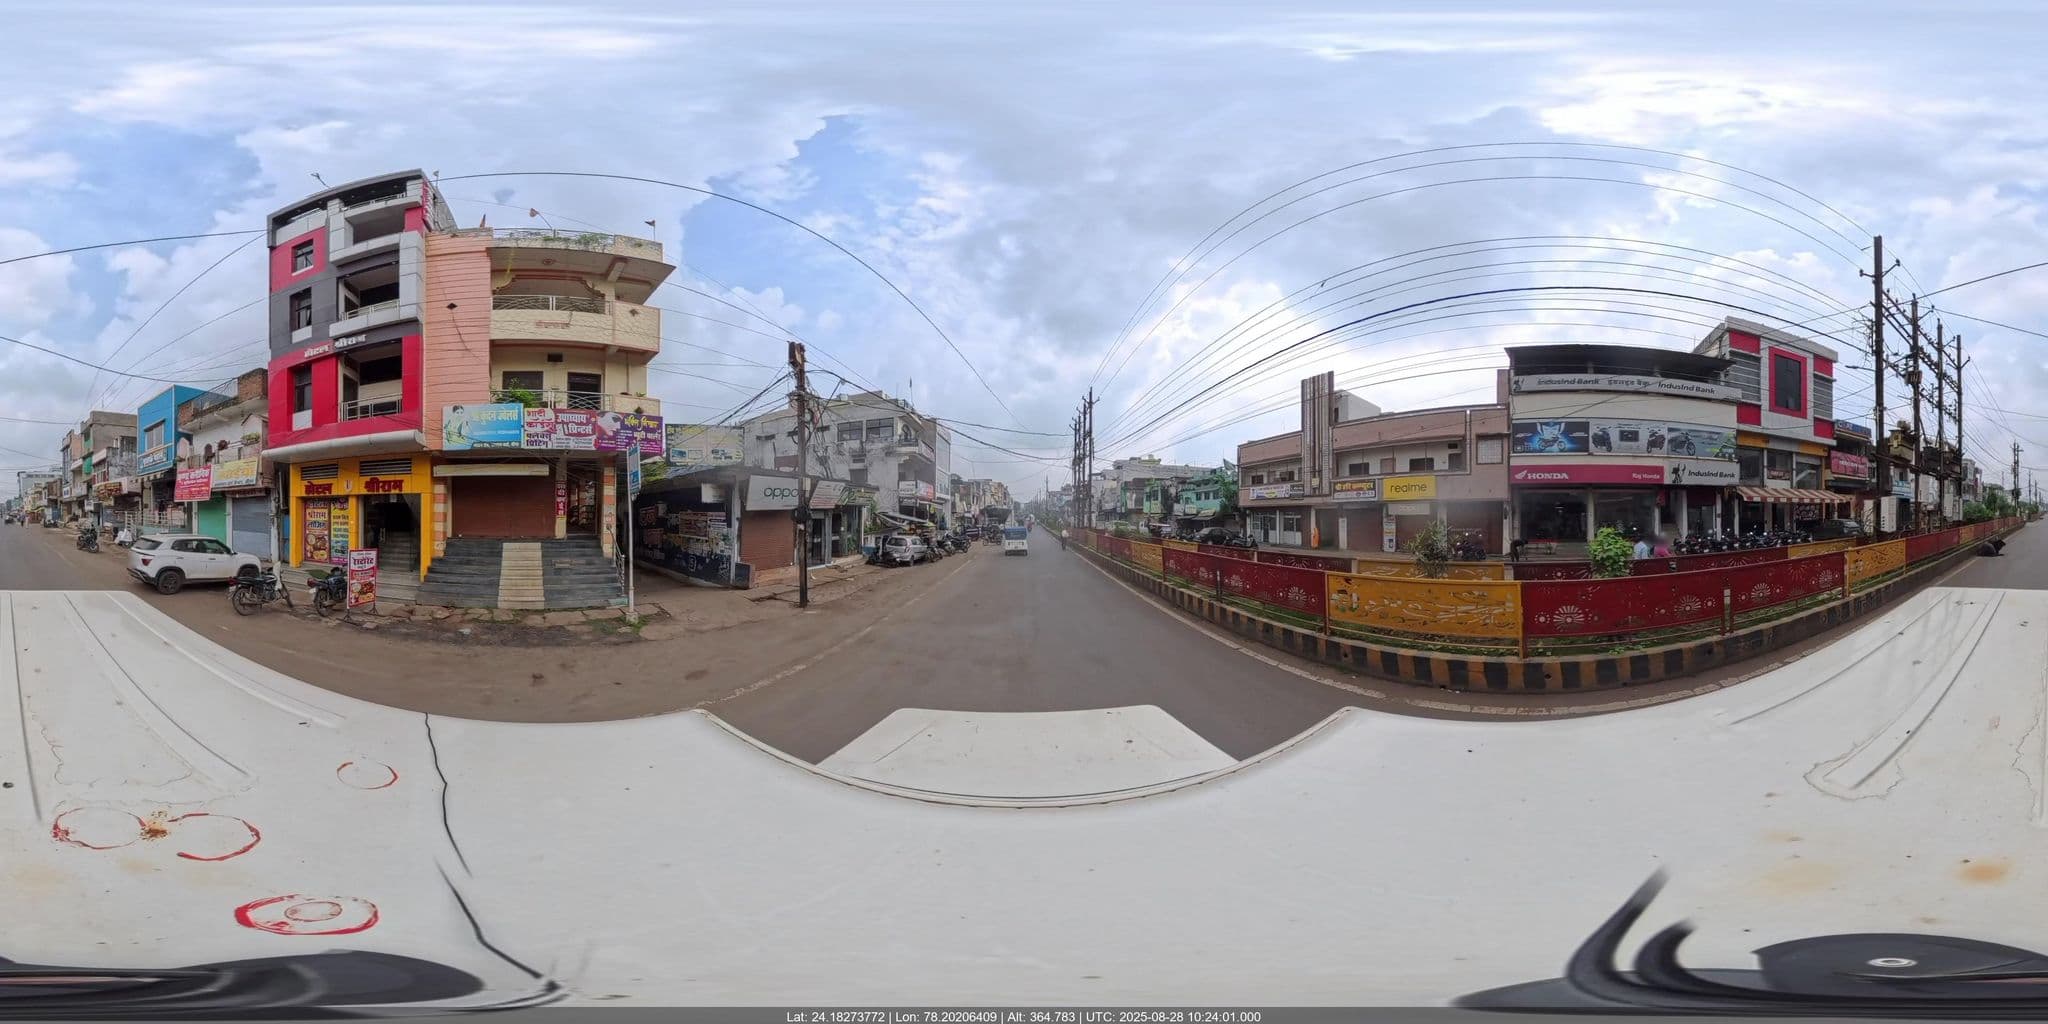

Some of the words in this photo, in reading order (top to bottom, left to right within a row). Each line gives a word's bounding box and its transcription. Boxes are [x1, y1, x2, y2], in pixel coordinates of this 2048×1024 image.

[1537, 378, 1576, 386] IndusInd
[1657, 381, 1695, 391] IndusInd
[1695, 386, 1716, 395] Bank
[1527, 472, 1570, 480] HONDA
[1688, 470, 1718, 479] IndusInd
[1719, 471, 1736, 479] Bank
[304, 480, 333, 495] होटल
[363, 476, 404, 493] श्रीराम
[1390, 482, 1428, 494] realme
[764, 487, 799, 500] oppo
